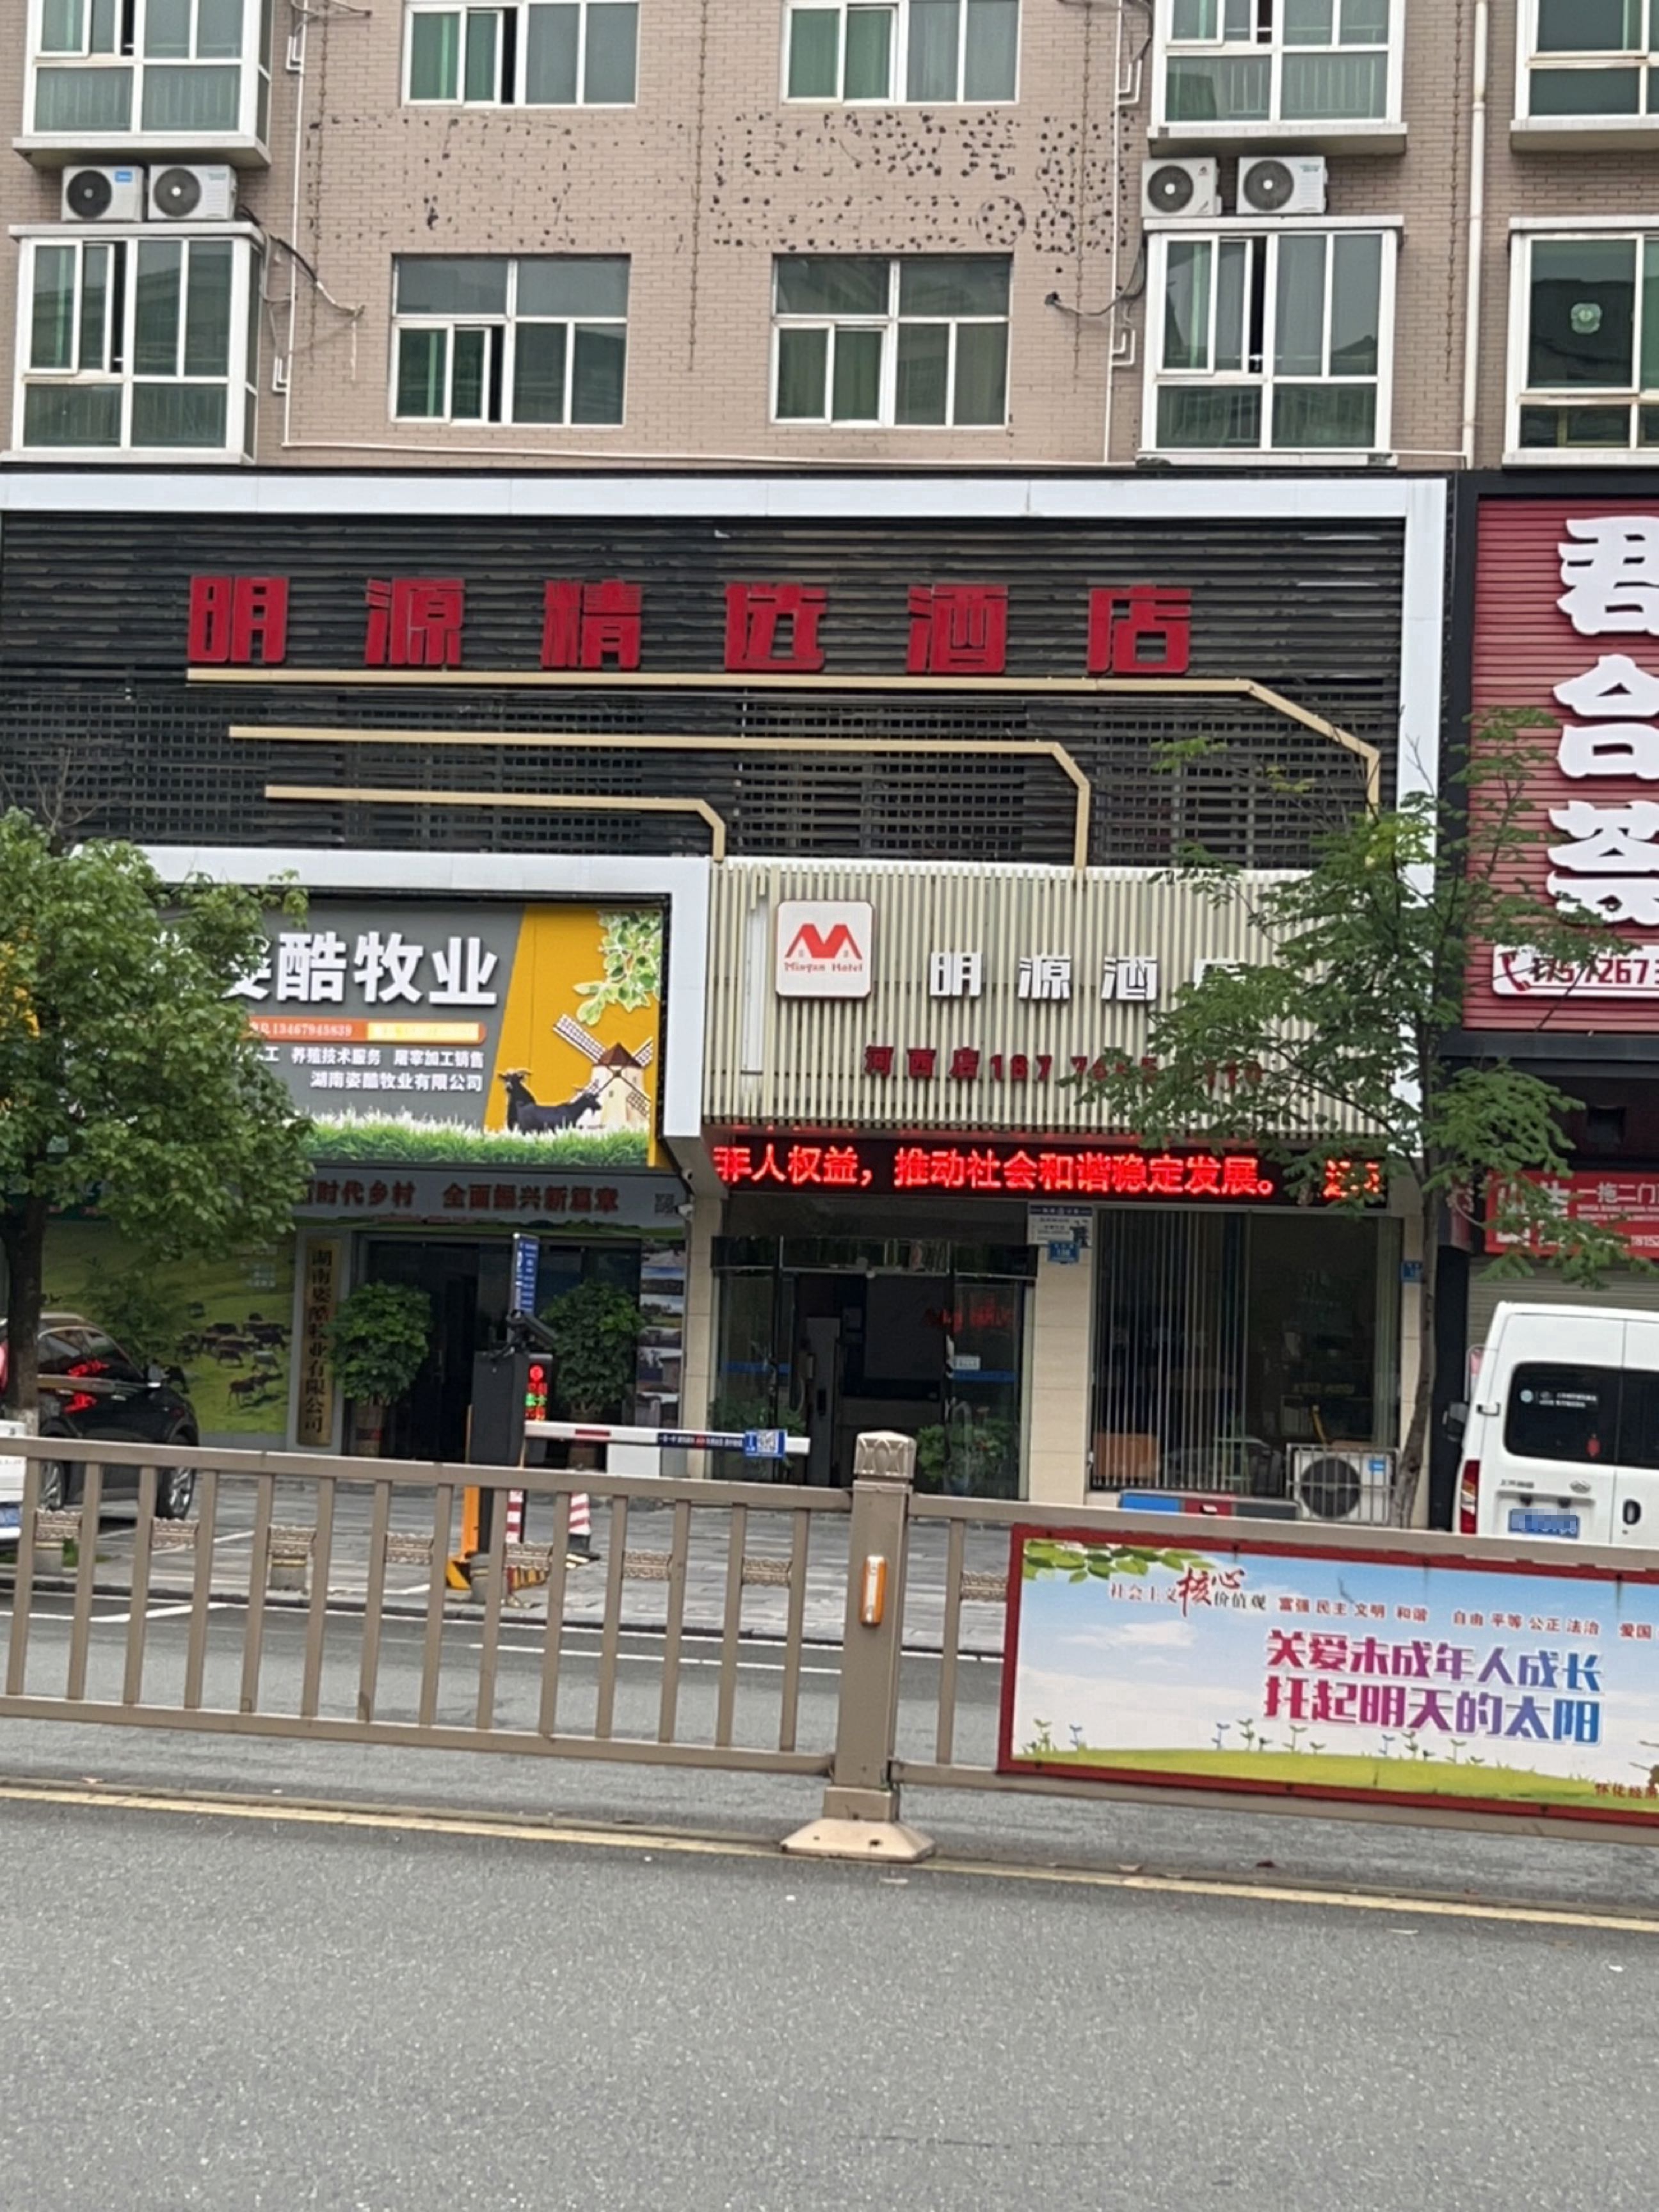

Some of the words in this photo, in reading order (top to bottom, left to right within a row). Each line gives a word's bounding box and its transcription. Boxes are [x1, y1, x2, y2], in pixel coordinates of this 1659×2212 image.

[187, 575, 1192, 676] 明源精选酒店
[832, 963, 862, 972] Hotel
[291, 1046, 381, 1065] 养殖技术服务
[1279, 1596, 1310, 1614] 富强
[1316, 1598, 1347, 1616] 民主
[1354, 1603, 1385, 1619] 文明
[1396, 1605, 1428, 1623] 和谐
[1453, 1609, 1484, 1626] 自由
[1491, 1612, 1522, 1630] 平等
[1529, 1617, 1560, 1632] 公正
[1566, 1619, 1599, 1635] 法治
[1620, 1622, 1653, 1639] 爱国
[1267, 1629, 1602, 1692] 关爱未成年人成长
[1263, 1674, 1600, 1743] 托起明天的太阳
